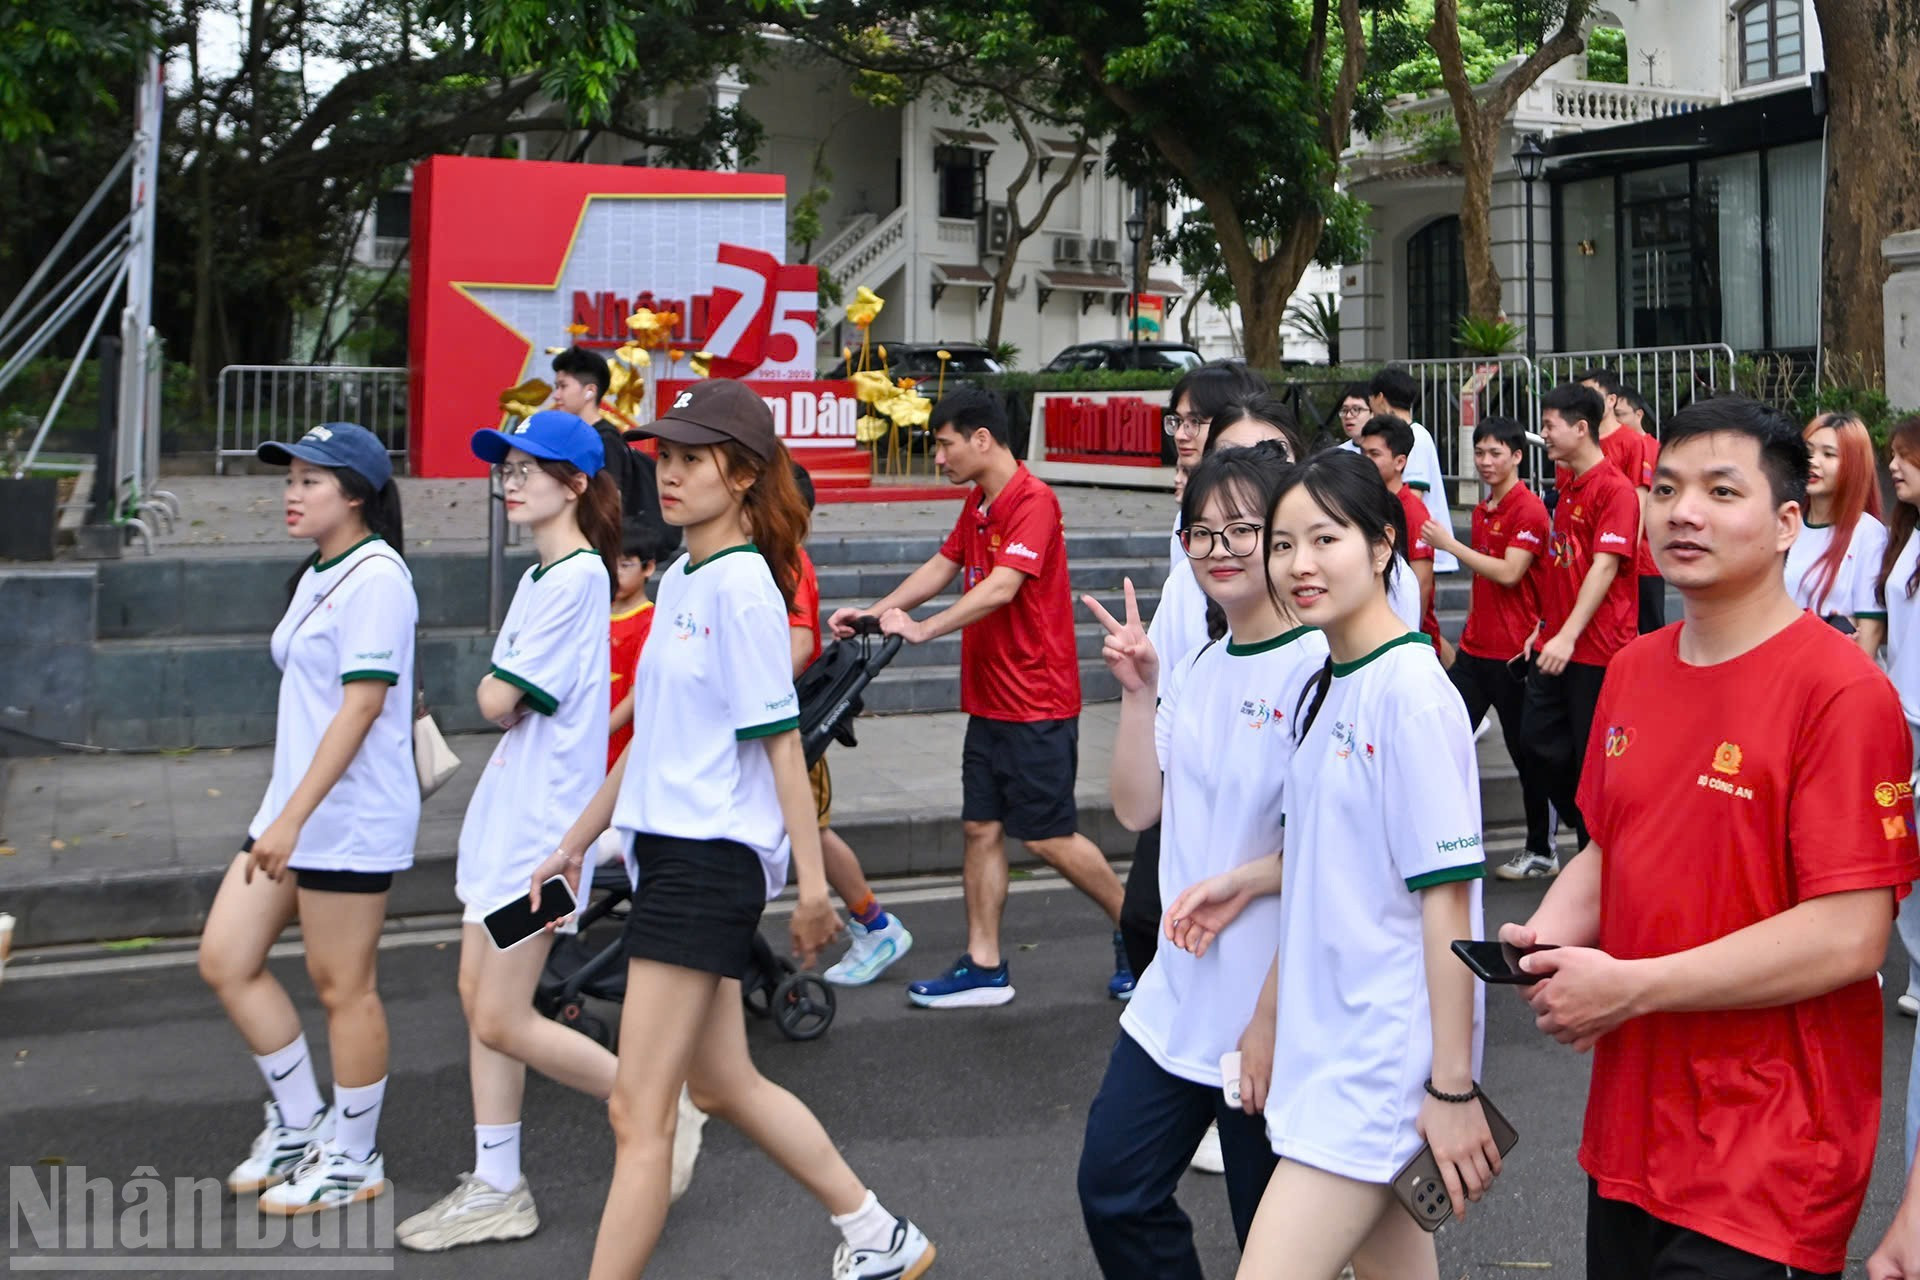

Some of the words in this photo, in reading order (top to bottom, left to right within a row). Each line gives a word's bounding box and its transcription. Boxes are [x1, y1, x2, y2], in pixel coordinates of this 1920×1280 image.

[703, 258, 817, 368] 75
[791, 391, 857, 436] Dân
[1735, 786, 1753, 800] AN
